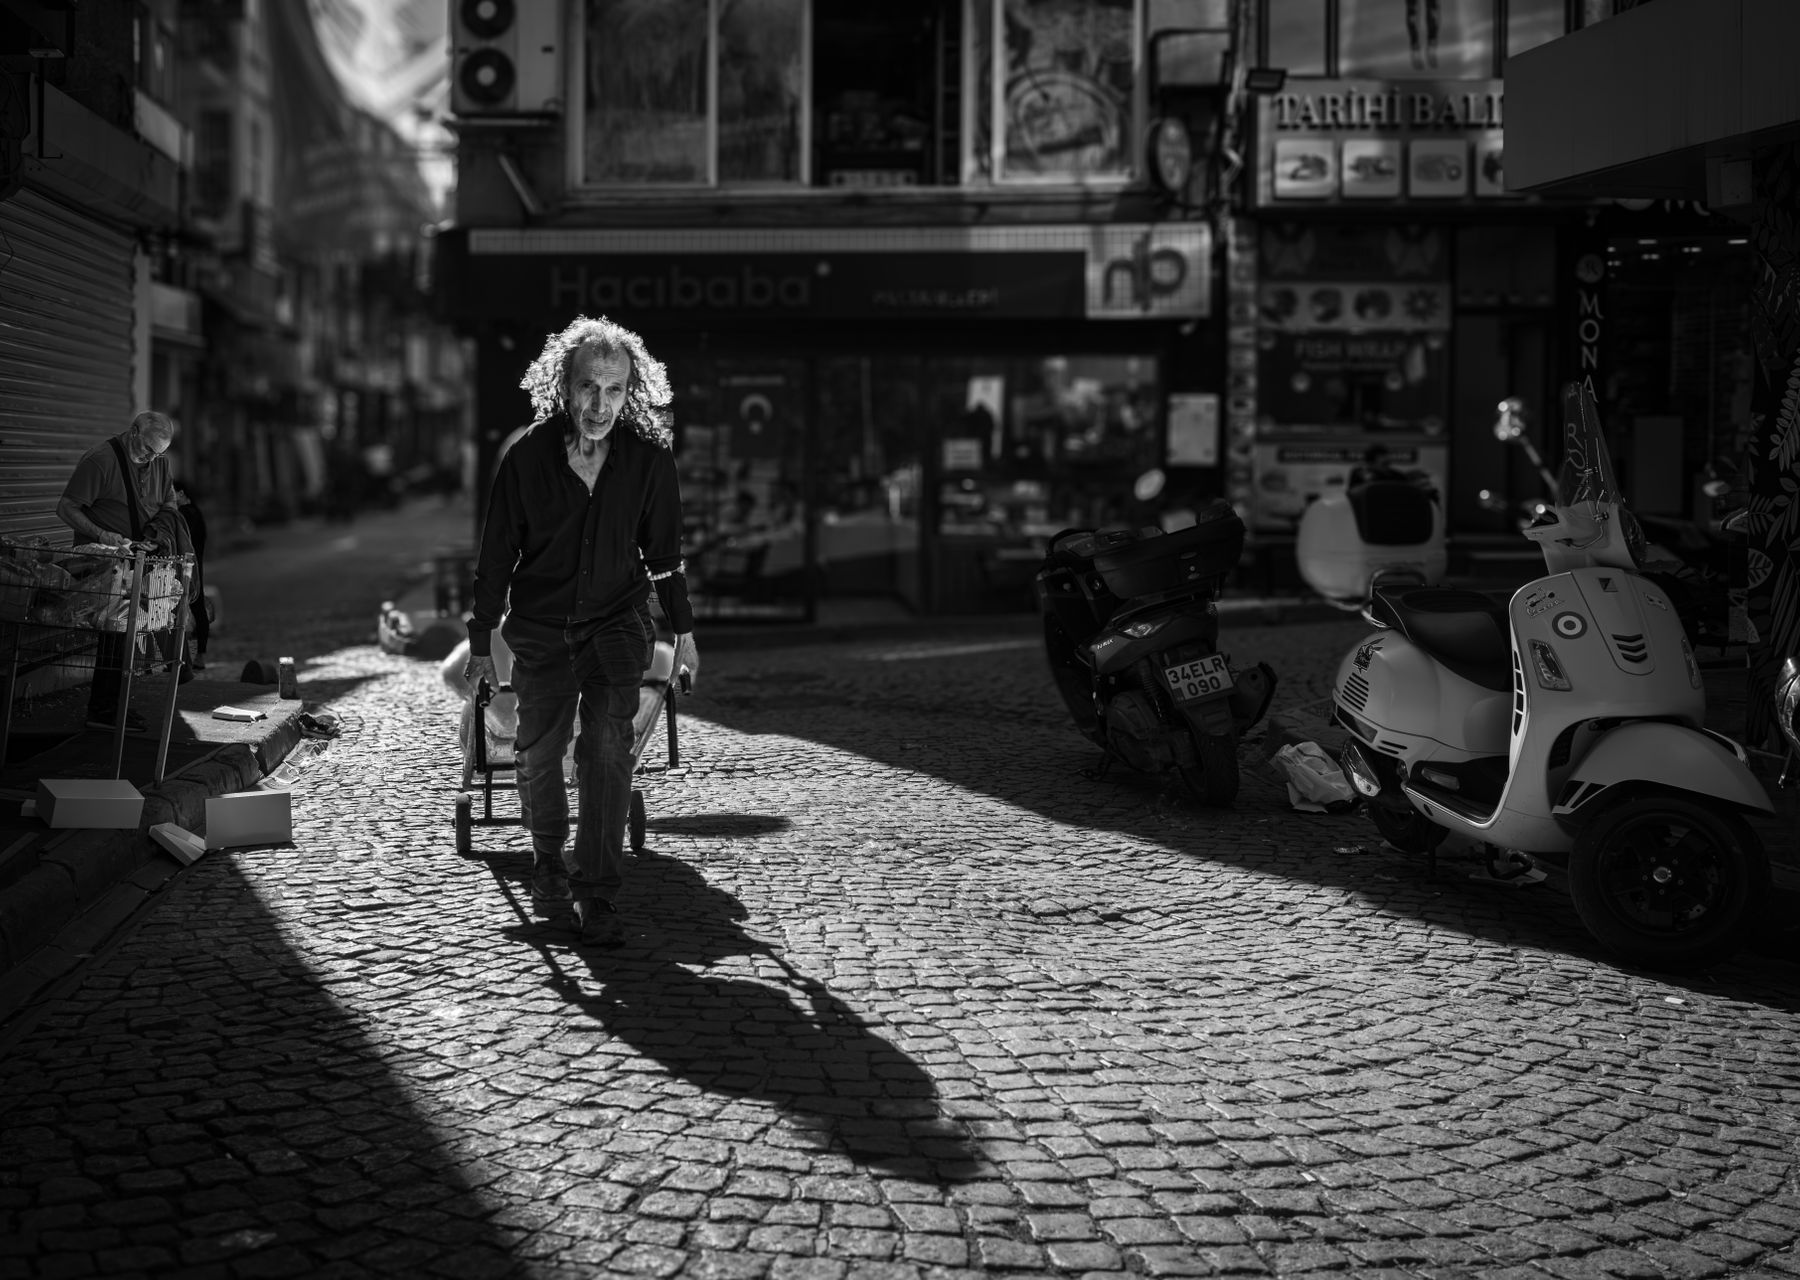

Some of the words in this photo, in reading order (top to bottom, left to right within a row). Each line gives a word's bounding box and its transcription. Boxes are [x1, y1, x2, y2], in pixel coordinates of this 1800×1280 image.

[1273, 87, 1402, 126] TARİHİ
[549, 263, 811, 308] Hacıbaba
[1187, 676, 1221, 697] 090
